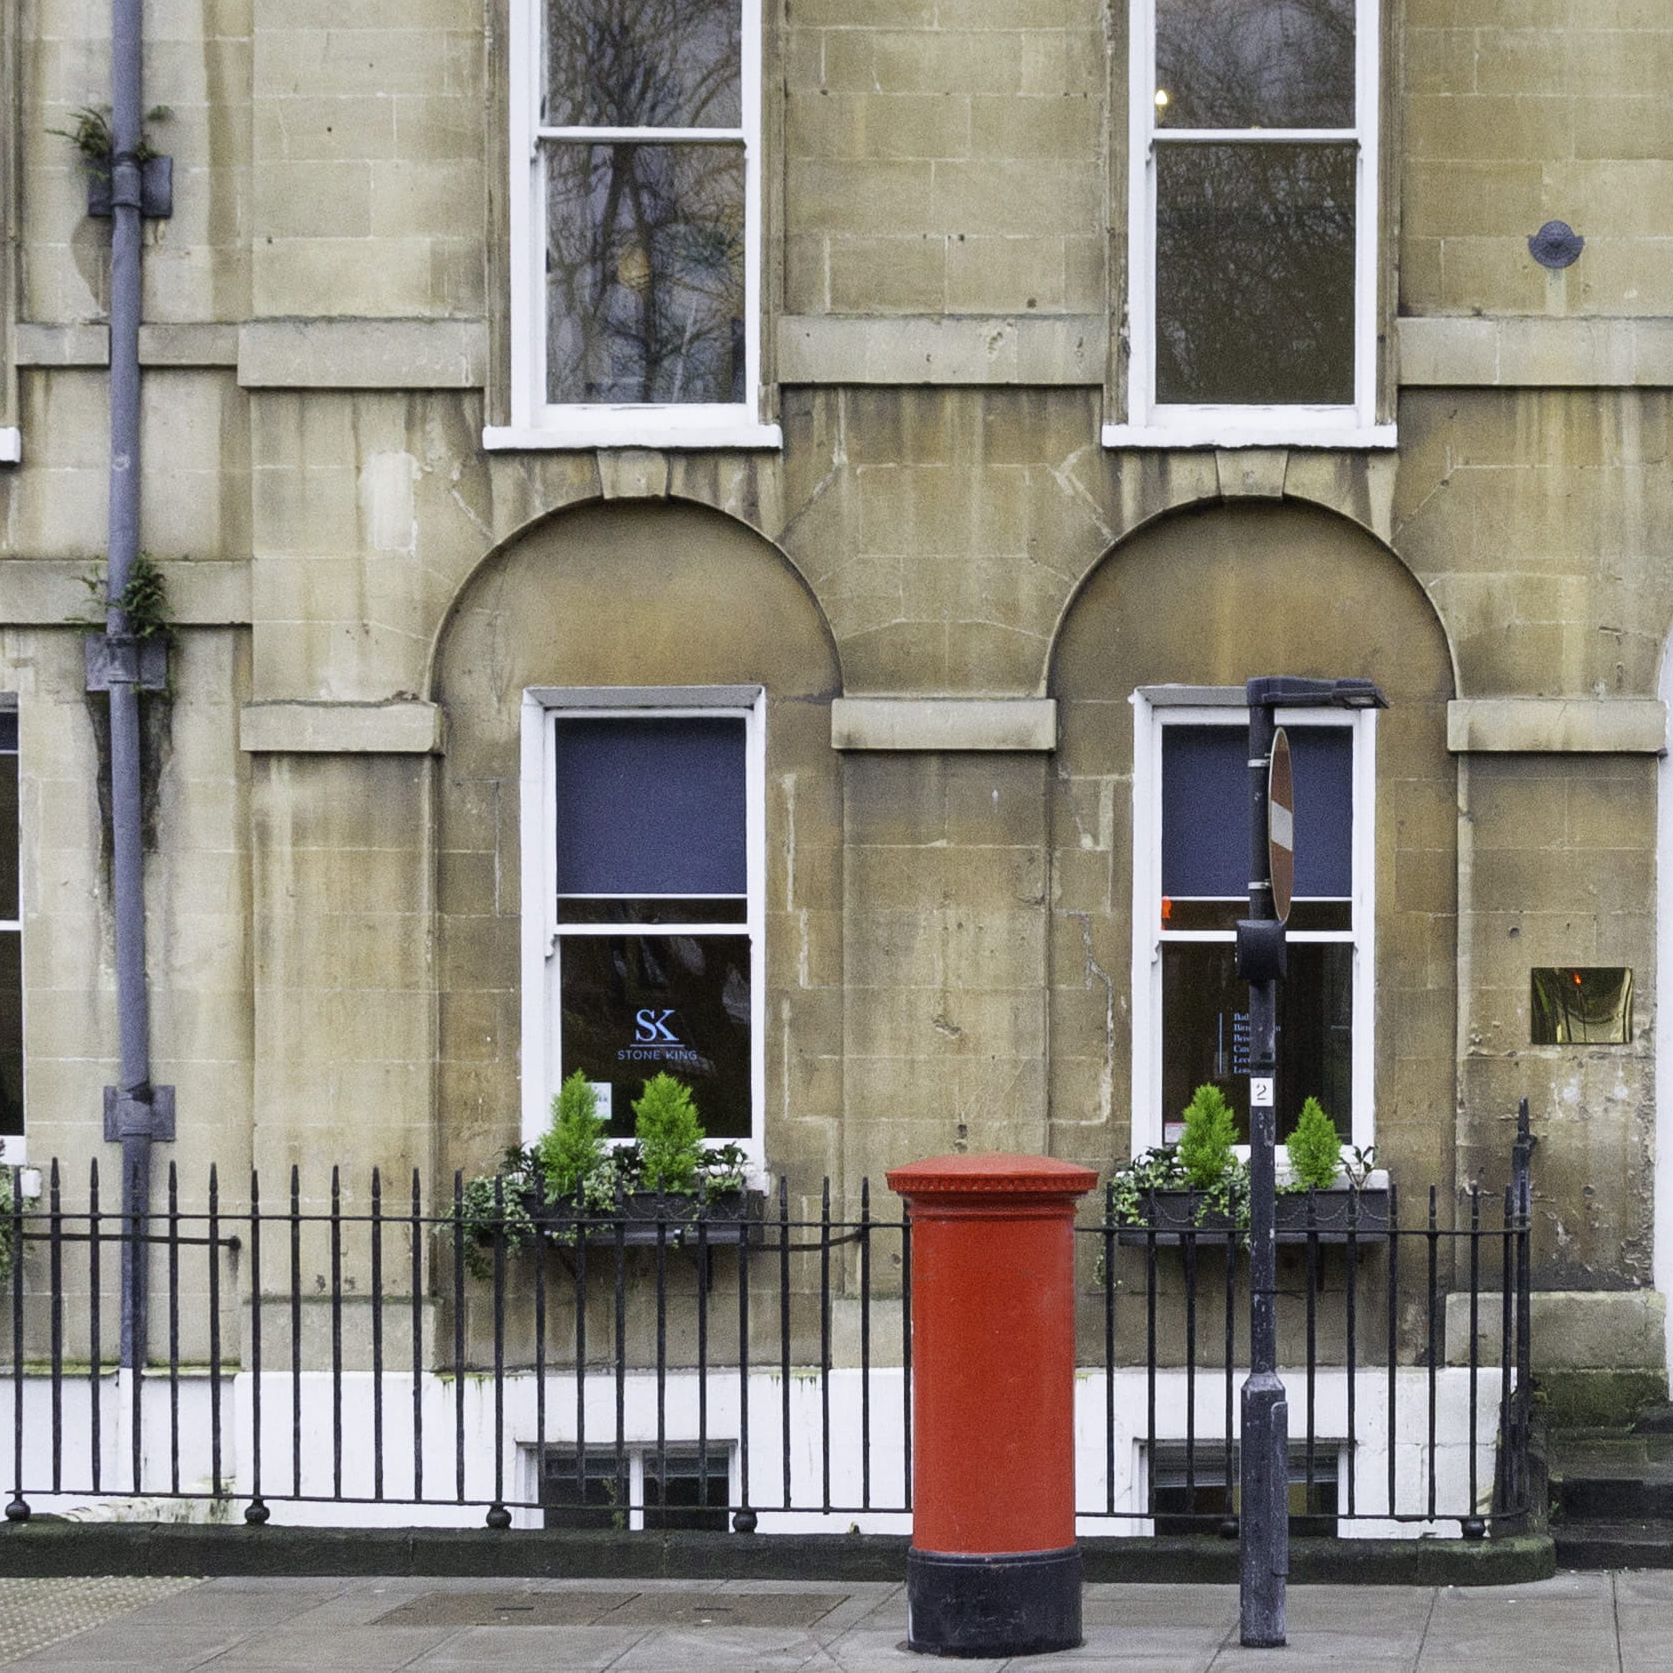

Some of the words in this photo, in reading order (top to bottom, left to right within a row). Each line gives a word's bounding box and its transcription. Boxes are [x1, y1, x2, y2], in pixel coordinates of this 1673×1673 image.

[635, 1008, 680, 1042] SK
[617, 1049, 661, 1061] STONE
[665, 1049, 698, 1061] KING
[1256, 1083, 1267, 1101] 2
